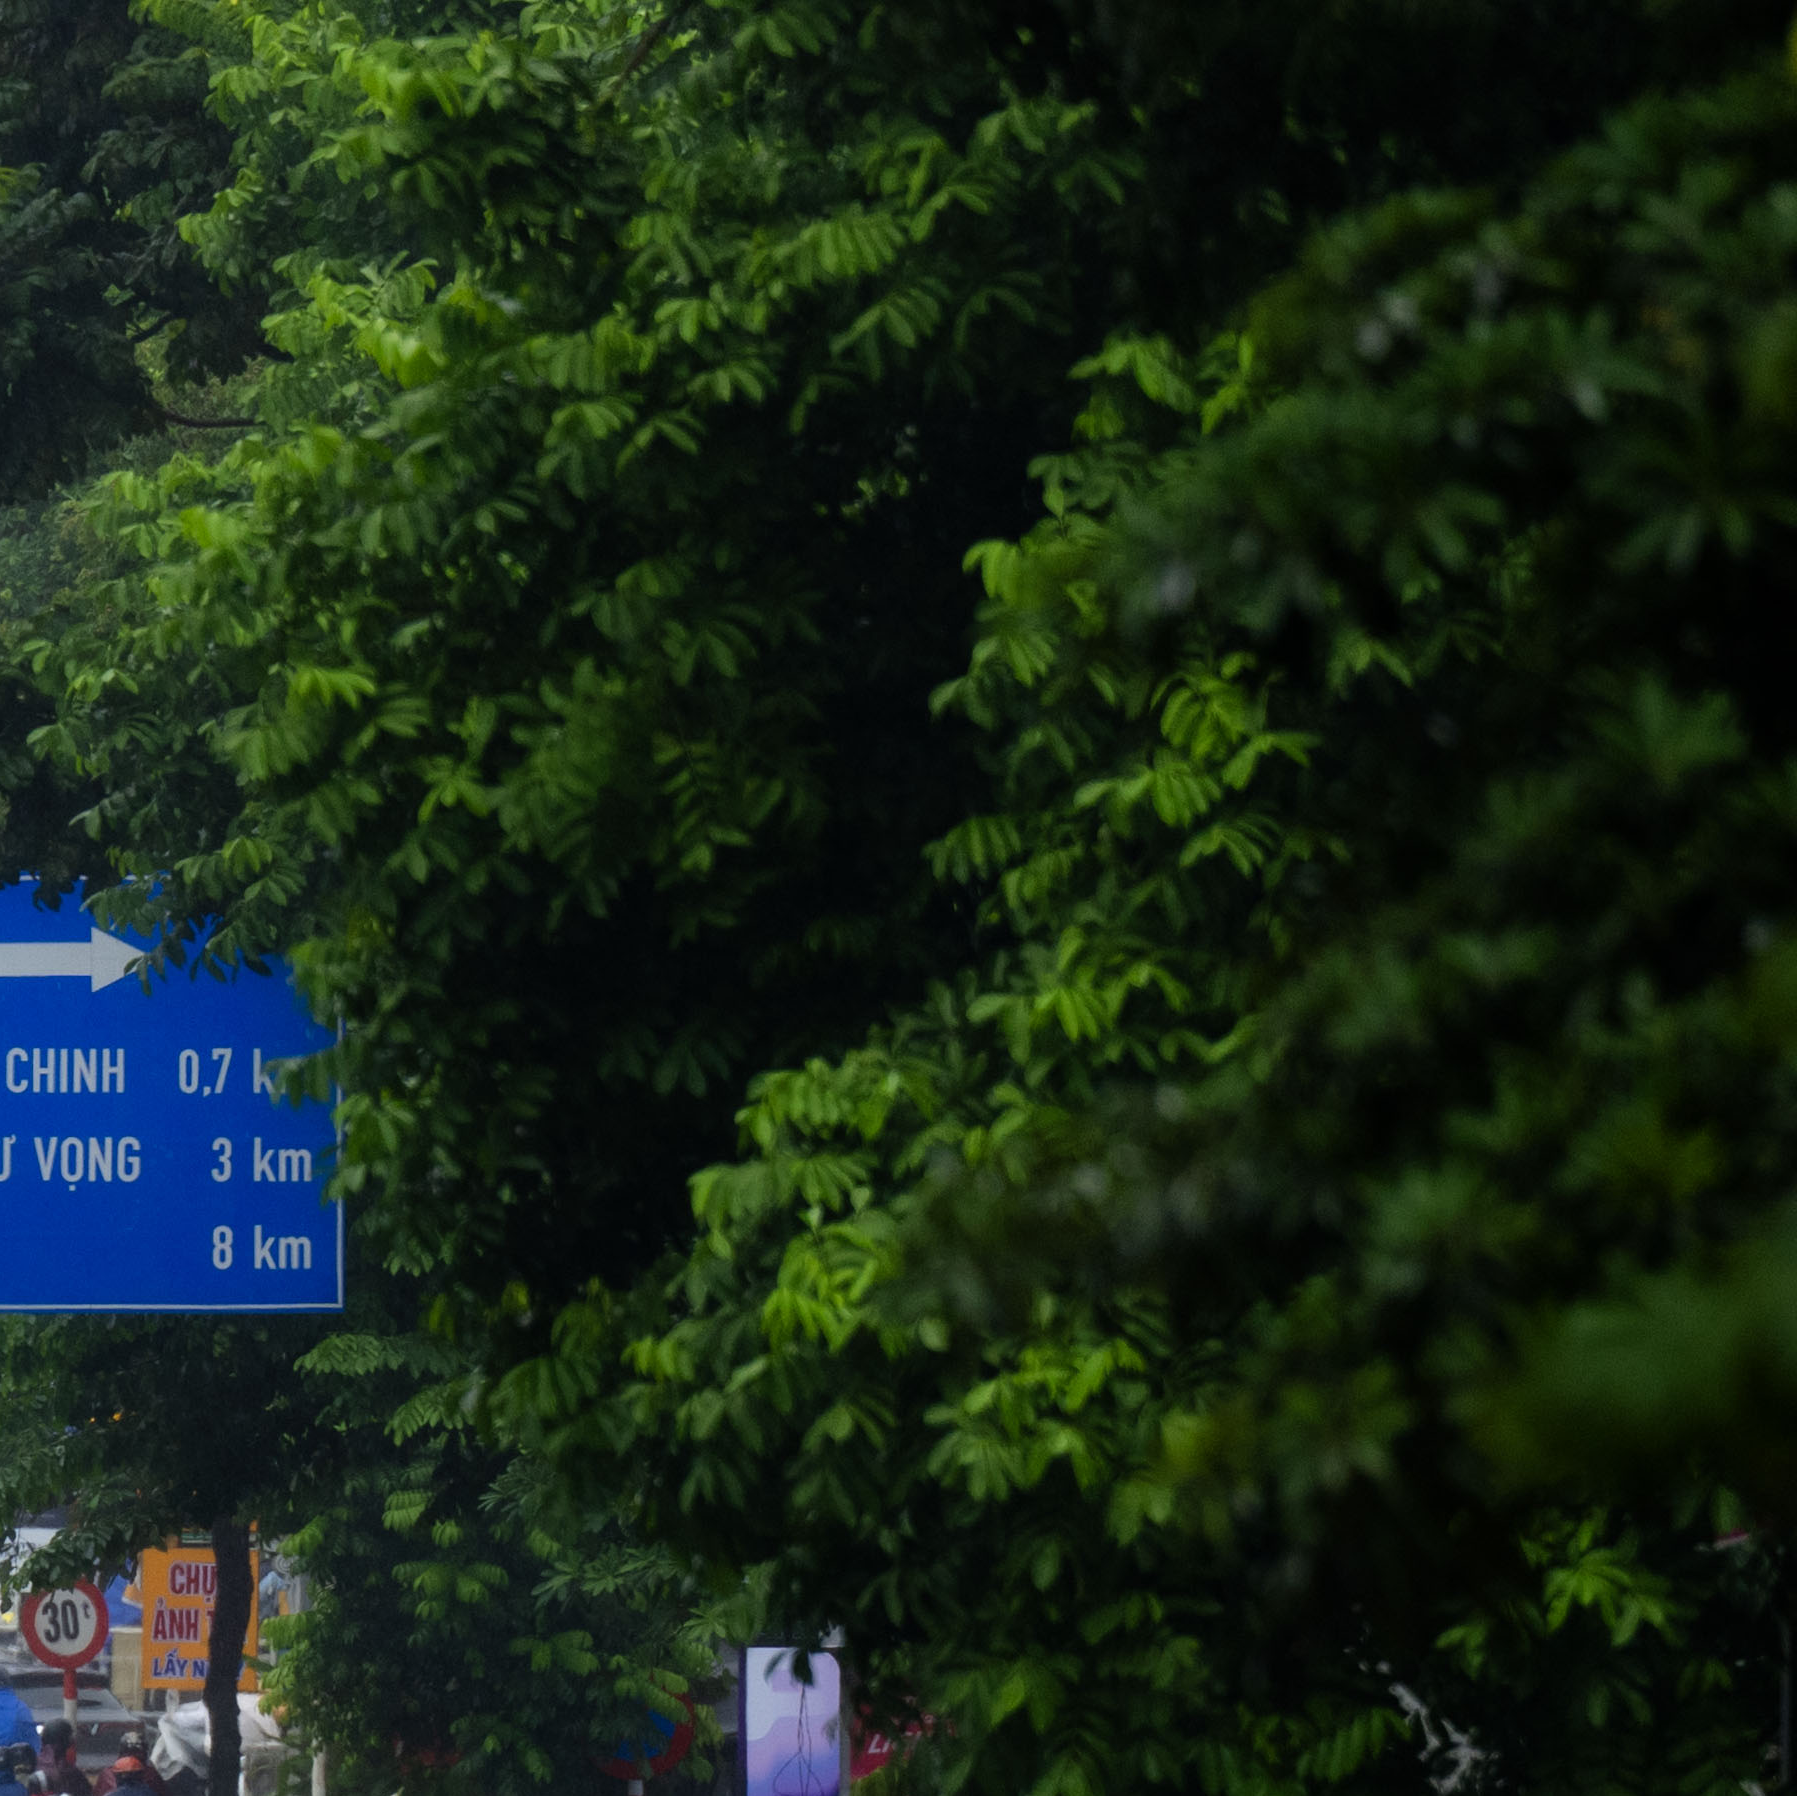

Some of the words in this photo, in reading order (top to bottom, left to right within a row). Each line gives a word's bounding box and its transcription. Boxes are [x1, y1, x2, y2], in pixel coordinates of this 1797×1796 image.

[7, 1048, 124, 1093] CHINH
[180, 1048, 231, 1096] 0,7
[35, 1137, 140, 1190] VỌNG
[212, 1138, 231, 1181] 3
[254, 1138, 311, 1181] km
[213, 1226, 232, 1269] 8
[255, 1225, 311, 1269] km
[153, 1597, 200, 1642] ẢNH
[153, 1648, 188, 1679] LẤY
